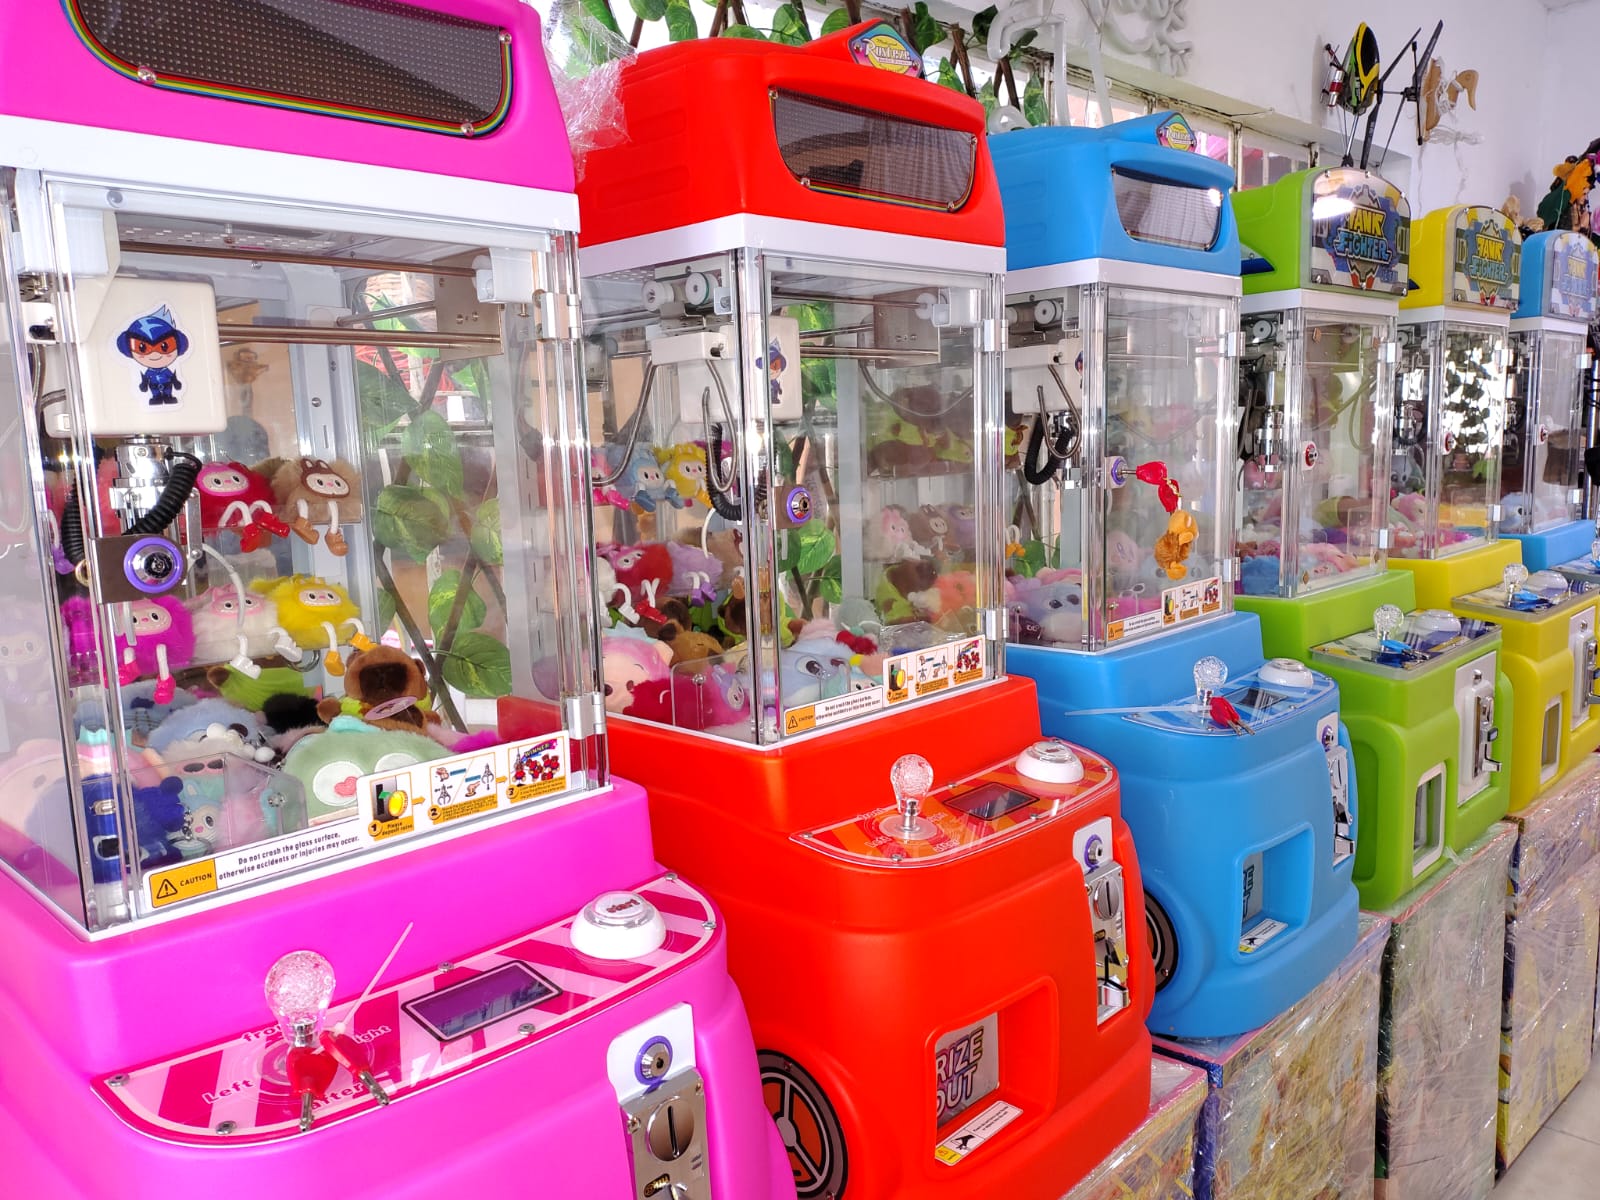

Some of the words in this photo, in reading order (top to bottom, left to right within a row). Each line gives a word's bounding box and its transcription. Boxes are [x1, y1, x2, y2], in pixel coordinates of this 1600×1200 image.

[1348, 207, 1384, 237] TANK
[1336, 231, 1391, 262] FIGHTER
[1477, 236, 1504, 262] TANK
[508, 788, 514, 796] 3
[430, 808, 438, 816] 2
[371, 824, 377, 832] 1
[218, 865, 255, 880] otherwise
[256, 855, 290, 870] accidents
[290, 852, 298, 860] or
[299, 844, 326, 858] injuries
[326, 840, 340, 850] may
[249, 854, 260, 862] not
[262, 848, 281, 858] crash
[282, 844, 294, 852] the
[295, 840, 313, 851] glass
[180, 872, 212, 887] CAUTION
[352, 1025, 392, 1044] ight
[936, 1026, 984, 1082] RIZE
[202, 1079, 256, 1104] Left
